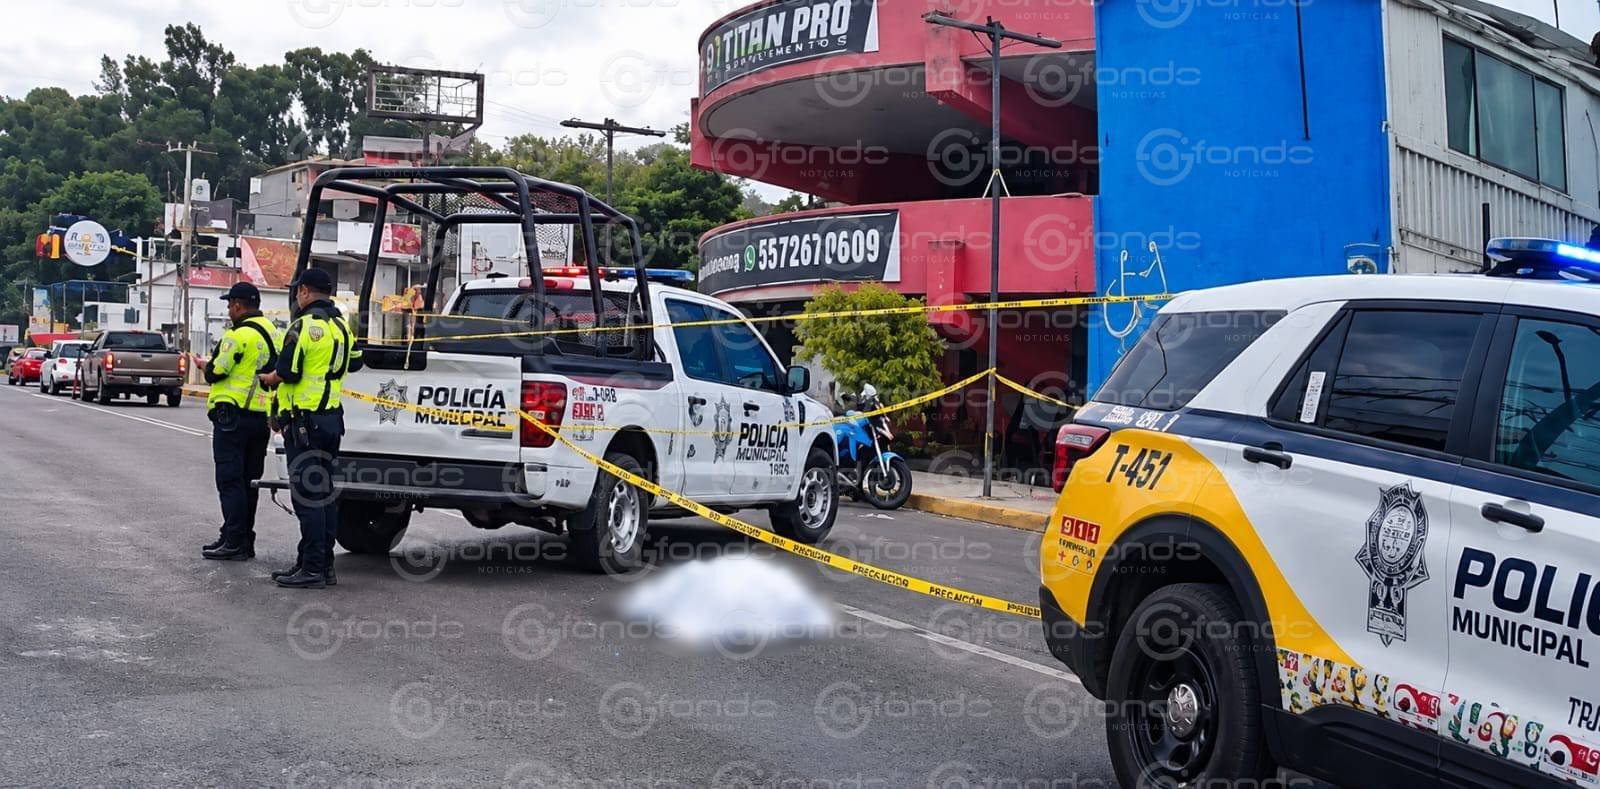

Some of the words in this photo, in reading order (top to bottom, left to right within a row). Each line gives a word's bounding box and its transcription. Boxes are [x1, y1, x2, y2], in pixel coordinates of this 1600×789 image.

[723, 12, 786, 62] TITAN
[791, 0, 852, 44] PRO
[758, 229, 880, 271] 5572670609
[417, 384, 507, 409] POLICÍA
[738, 420, 788, 451] POLICÍA
[1106, 444, 1173, 490] T-451
[1063, 518, 1098, 542] 911
[1452, 606, 1590, 668] MUNICIPAL
